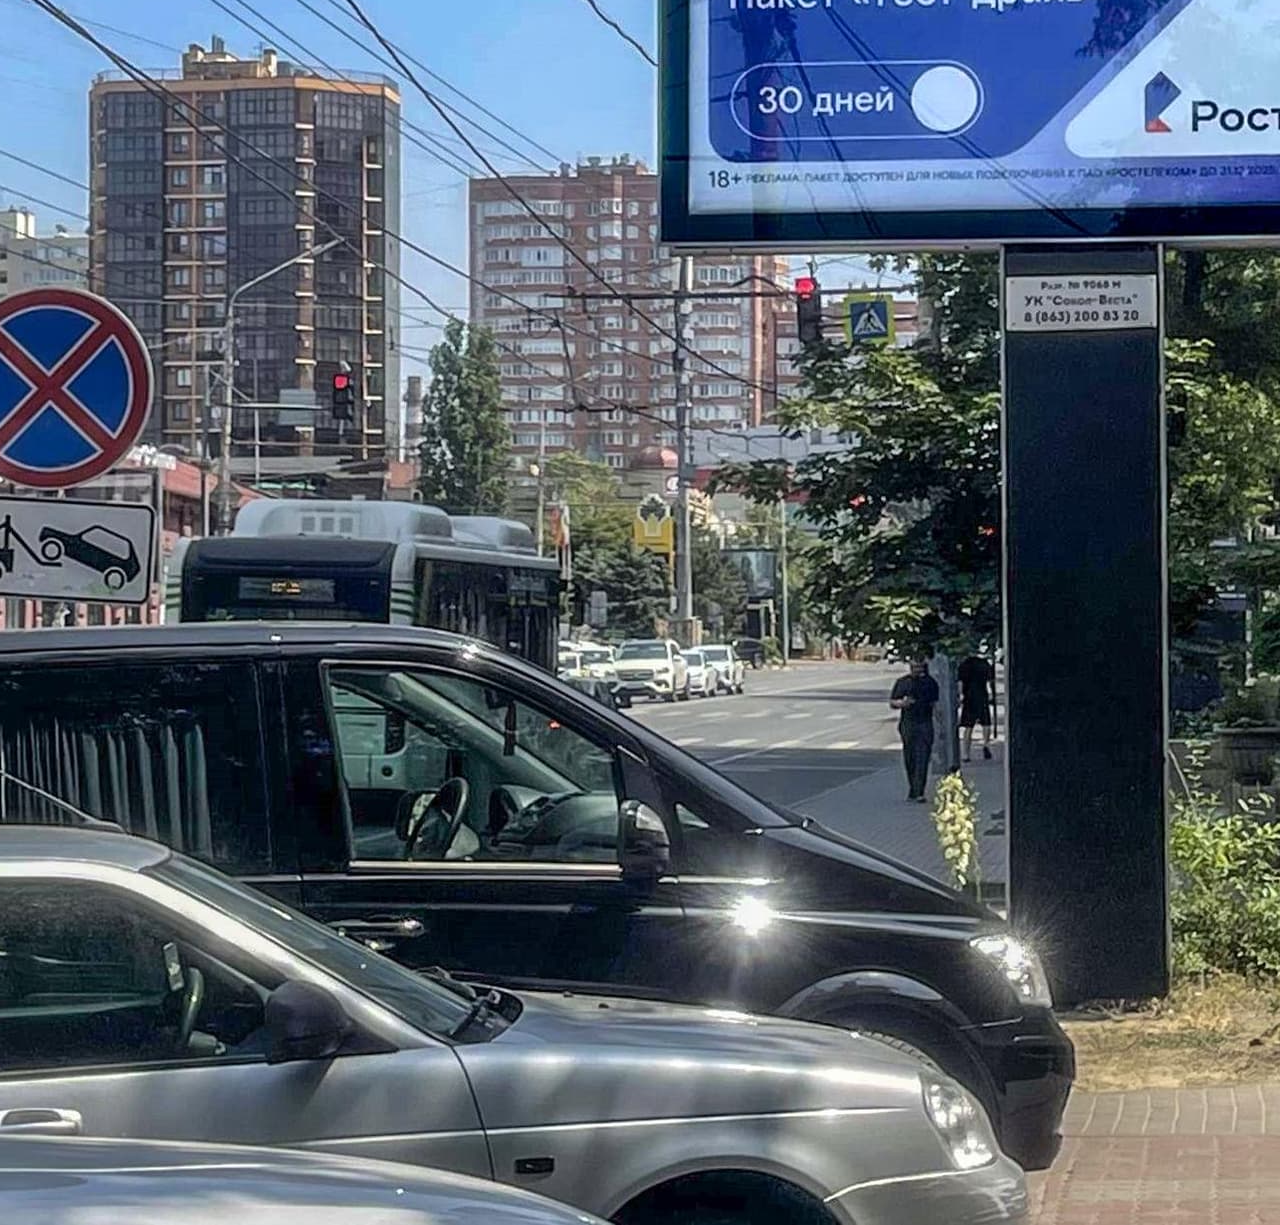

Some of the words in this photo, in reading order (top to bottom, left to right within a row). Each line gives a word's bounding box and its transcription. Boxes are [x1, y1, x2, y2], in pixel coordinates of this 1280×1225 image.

[758, 86, 803, 114] 30
[812, 86, 894, 117] дней
[709, 170, 742, 188] 18+
[1024, 295, 1043, 307] УК
[1024, 312, 1032, 322] 8
[1035, 310, 1070, 325] (863)
[1074, 311, 1099, 322] 200
[1103, 310, 1119, 321] 83
[1123, 310, 1139, 321] 20
